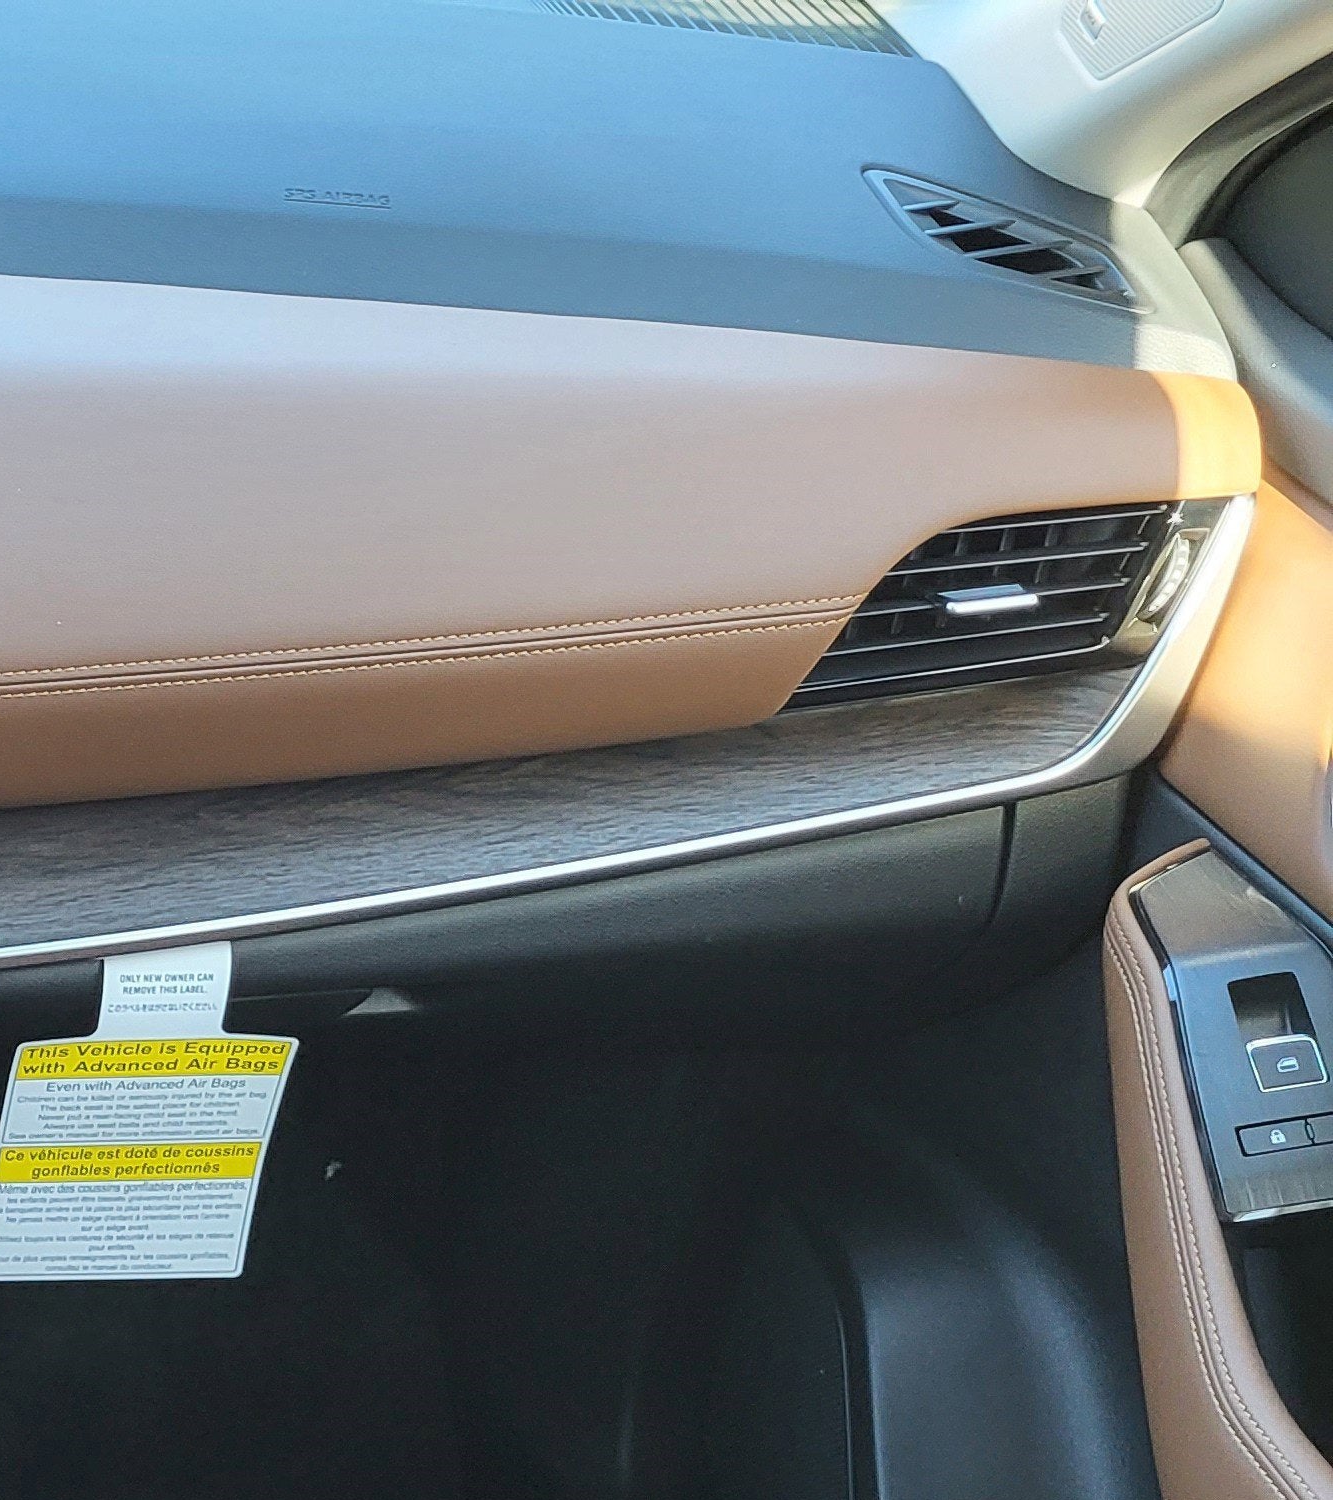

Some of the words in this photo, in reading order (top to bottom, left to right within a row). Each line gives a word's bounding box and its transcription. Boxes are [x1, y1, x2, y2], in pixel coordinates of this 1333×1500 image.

[120, 974, 141, 983] ONLY
[143, 974, 162, 983] NEW
[165, 973, 195, 982] OWNER
[197, 973, 214, 982] CAN
[123, 985, 157, 995] REMOVE
[159, 985, 177, 994] THIS
[26, 1046, 69, 1059] This
[76, 1044, 153, 1058] Vehicle
[158, 1043, 177, 1055] is
[183, 1041, 286, 1056] Equipped
[23, 1062, 66, 1075] with
[73, 1059, 179, 1073] Advanced
[186, 1058, 217, 1070] Air
[225, 1058, 280, 1073] Bags
[46, 1082, 82, 1093] Even
[84, 1081, 113, 1091] with
[115, 1079, 184, 1091] Advanced
[187, 1078, 208, 1089] Air
[211, 1078, 247, 1091] Bags
[5, 1150, 25, 1161] Ce
[30, 1149, 93, 1161] véhicule
[97, 1149, 121, 1160] est
[124, 1147, 158, 1159] doté
[162, 1147, 181, 1158] de
[184, 1146, 255, 1158] coussins
[32, 1164, 111, 1180] gonflables
[114, 1162, 221, 1179] perfectionnés
[31, 1186, 56, 1194] avec
[57, 1185, 76, 1193] des
